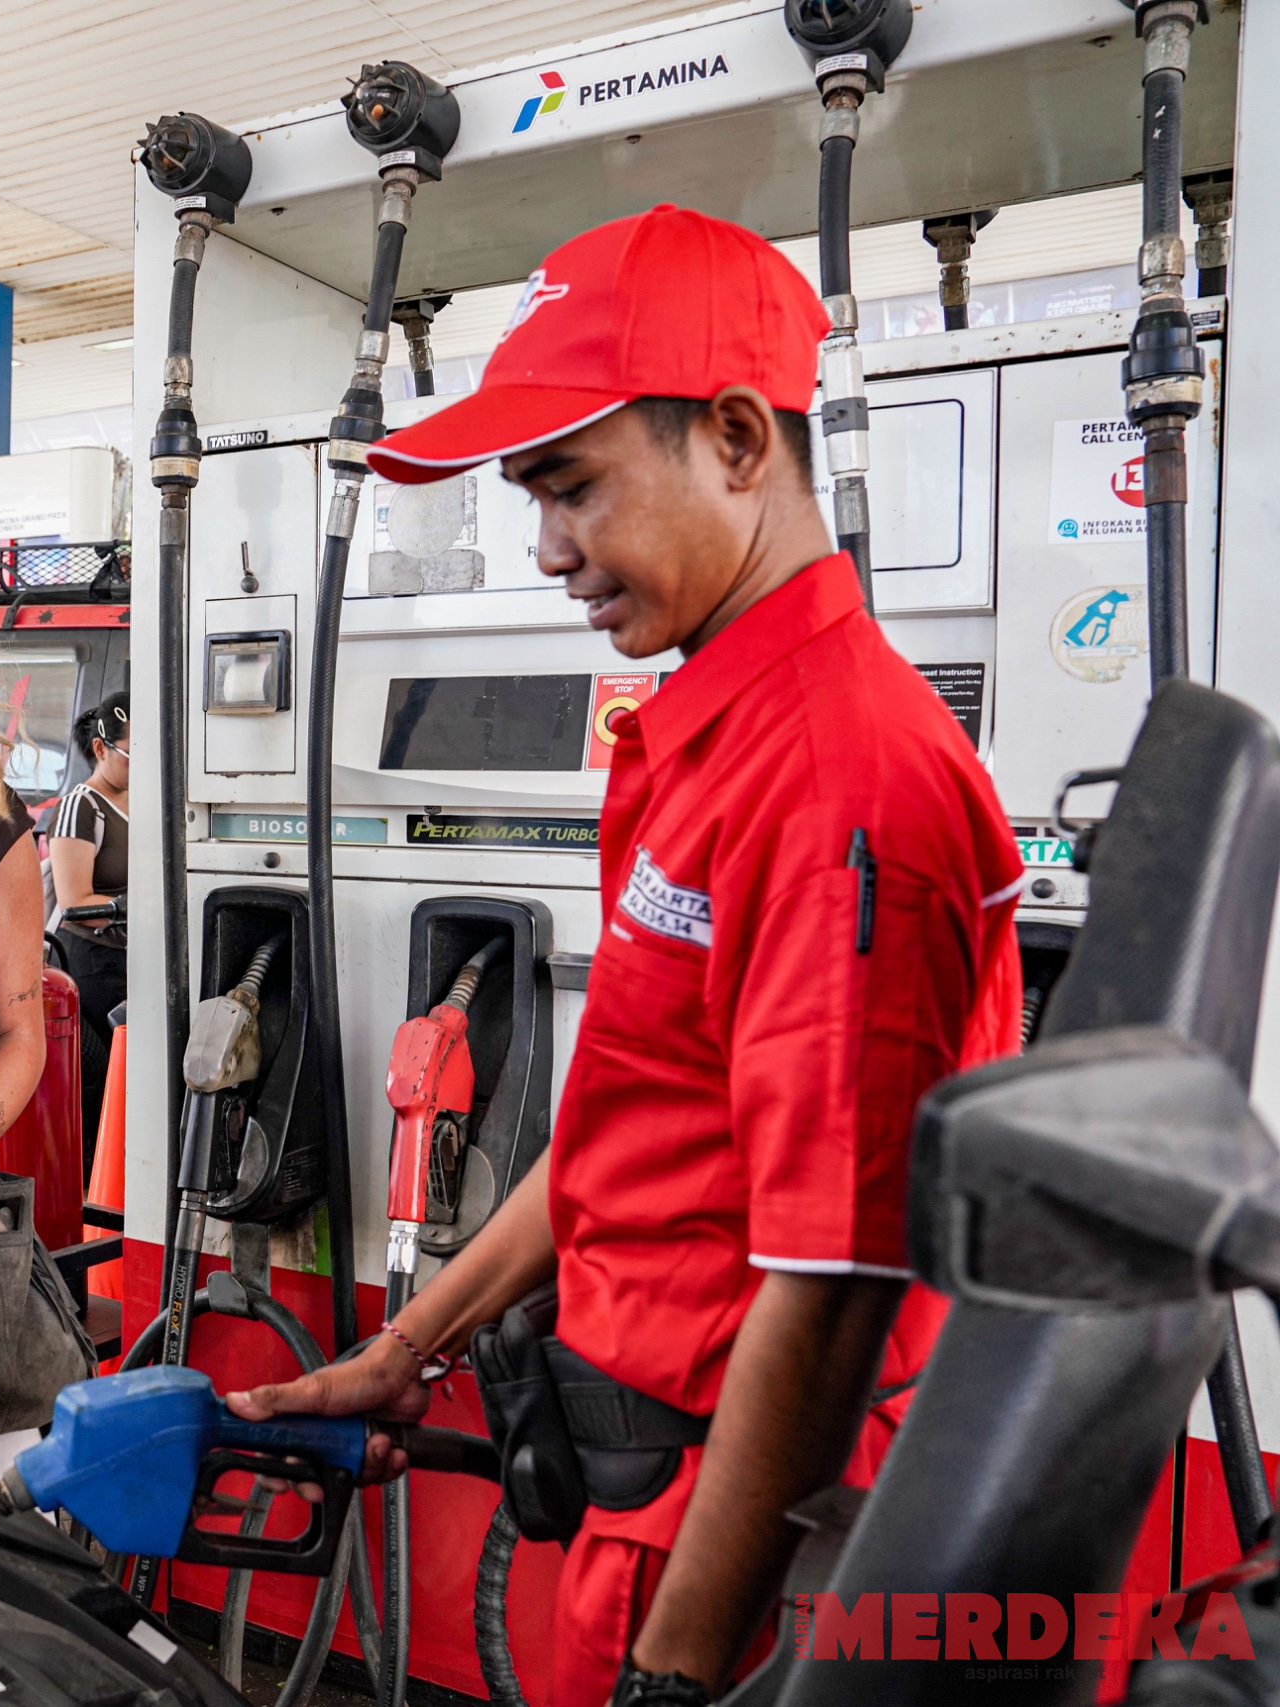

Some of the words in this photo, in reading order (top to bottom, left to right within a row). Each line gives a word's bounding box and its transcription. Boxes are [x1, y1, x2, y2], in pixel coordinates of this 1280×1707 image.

[580, 54, 729, 106] PERTAMINA
[1082, 421, 1143, 433] PERTAM
[210, 431, 265, 448] TATSUNO
[1081, 434, 1114, 444] CALL
[1118, 432, 1145, 442] CEN
[1114, 463, 1145, 491] 13
[1083, 519, 1132, 528] INFOKAN
[1135, 518, 1147, 526] BI
[1083, 526, 1132, 535] KELUHAN
[918, 669, 938, 677] reset
[939, 668, 982, 676] Instruction
[602, 677, 648, 685] EMERGENCY
[614, 686, 634, 694] STOP
[249, 819, 347, 837] BIOSOR
[413, 821, 543, 841] PERTAMAX
[545, 827, 600, 842] TURBO
[167, 1340, 178, 1361] SAE
[137, 1575, 147, 1592] WP
